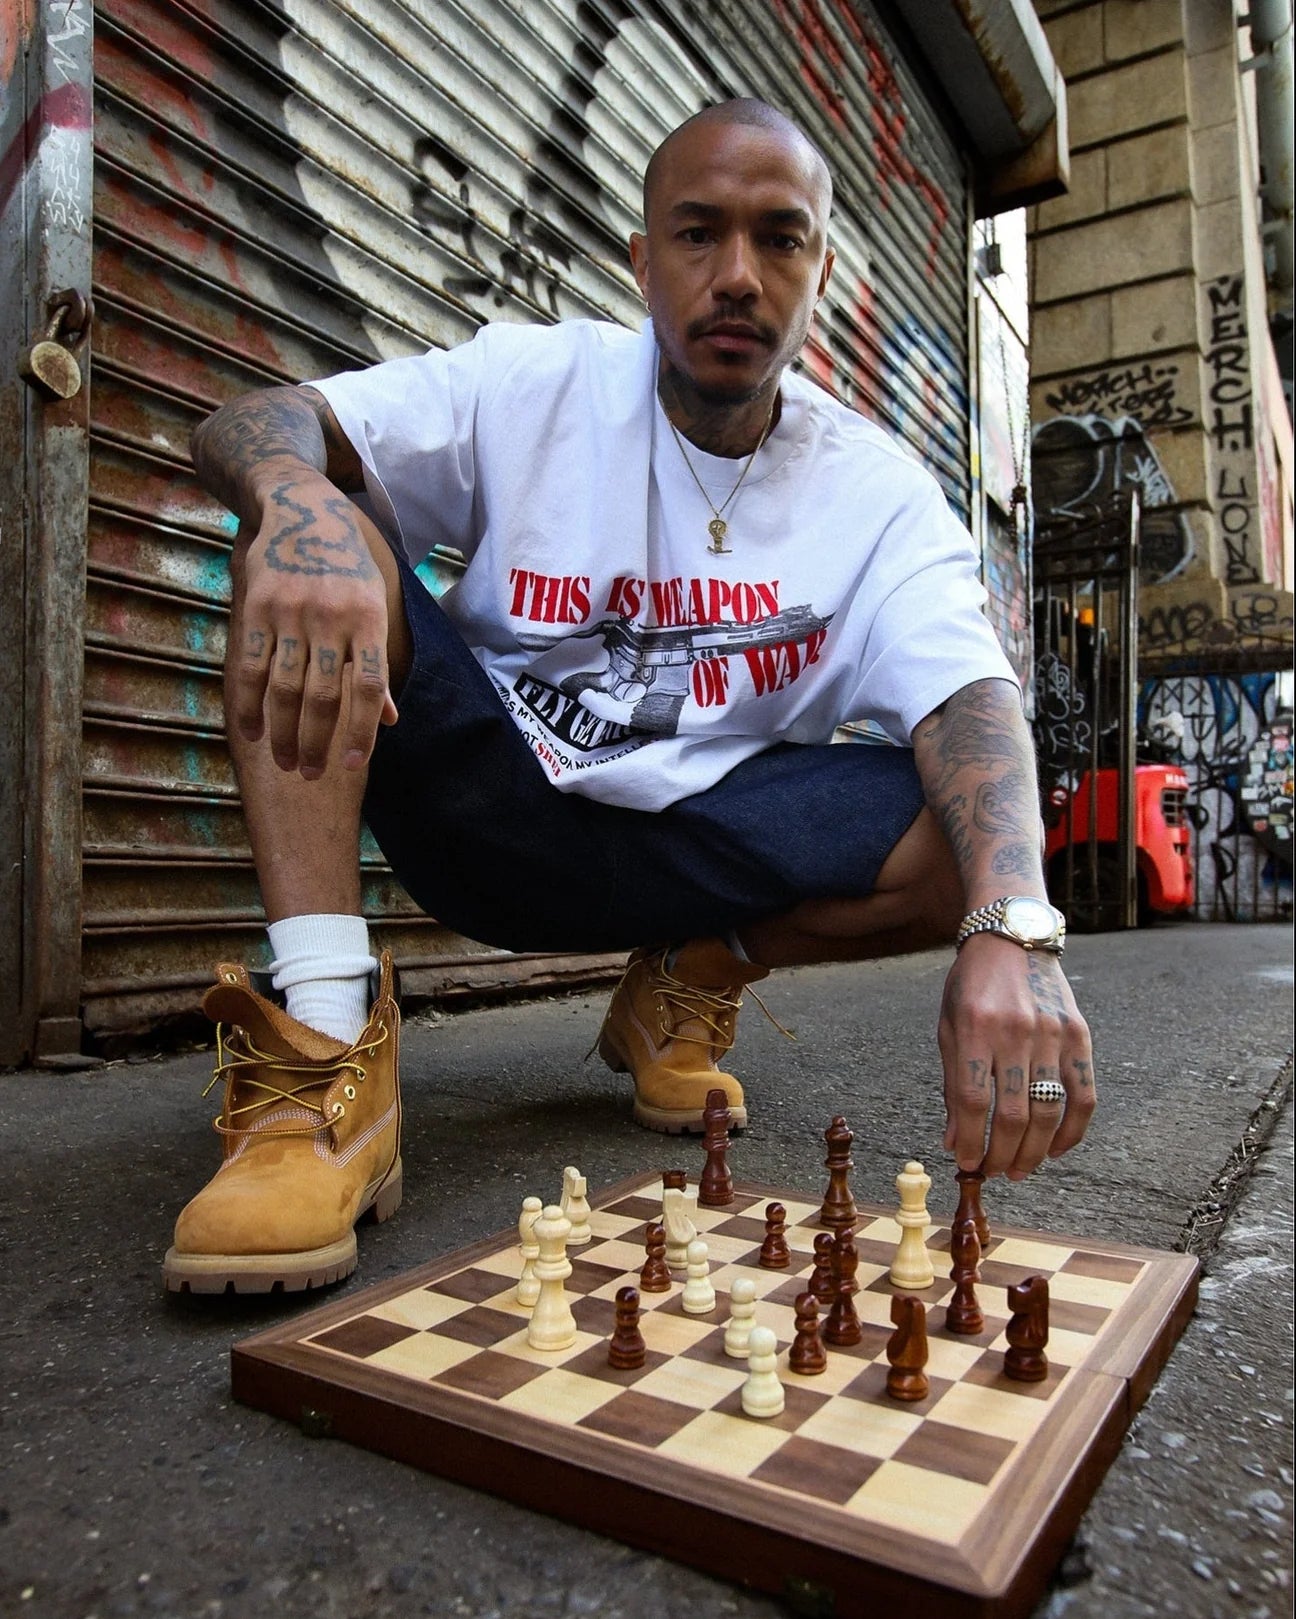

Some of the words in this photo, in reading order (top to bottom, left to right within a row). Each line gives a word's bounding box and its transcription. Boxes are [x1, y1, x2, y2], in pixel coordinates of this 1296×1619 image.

[509, 568, 591, 625] THIS
[604, 575, 645, 620] IS
[649, 574, 780, 627] WEAPON
[692, 656, 729, 708] OF
[743, 627, 827, 698] WAR
[519, 679, 575, 728] FLY
[518, 728, 539, 746] OT
[576, 760, 592, 770] MY
